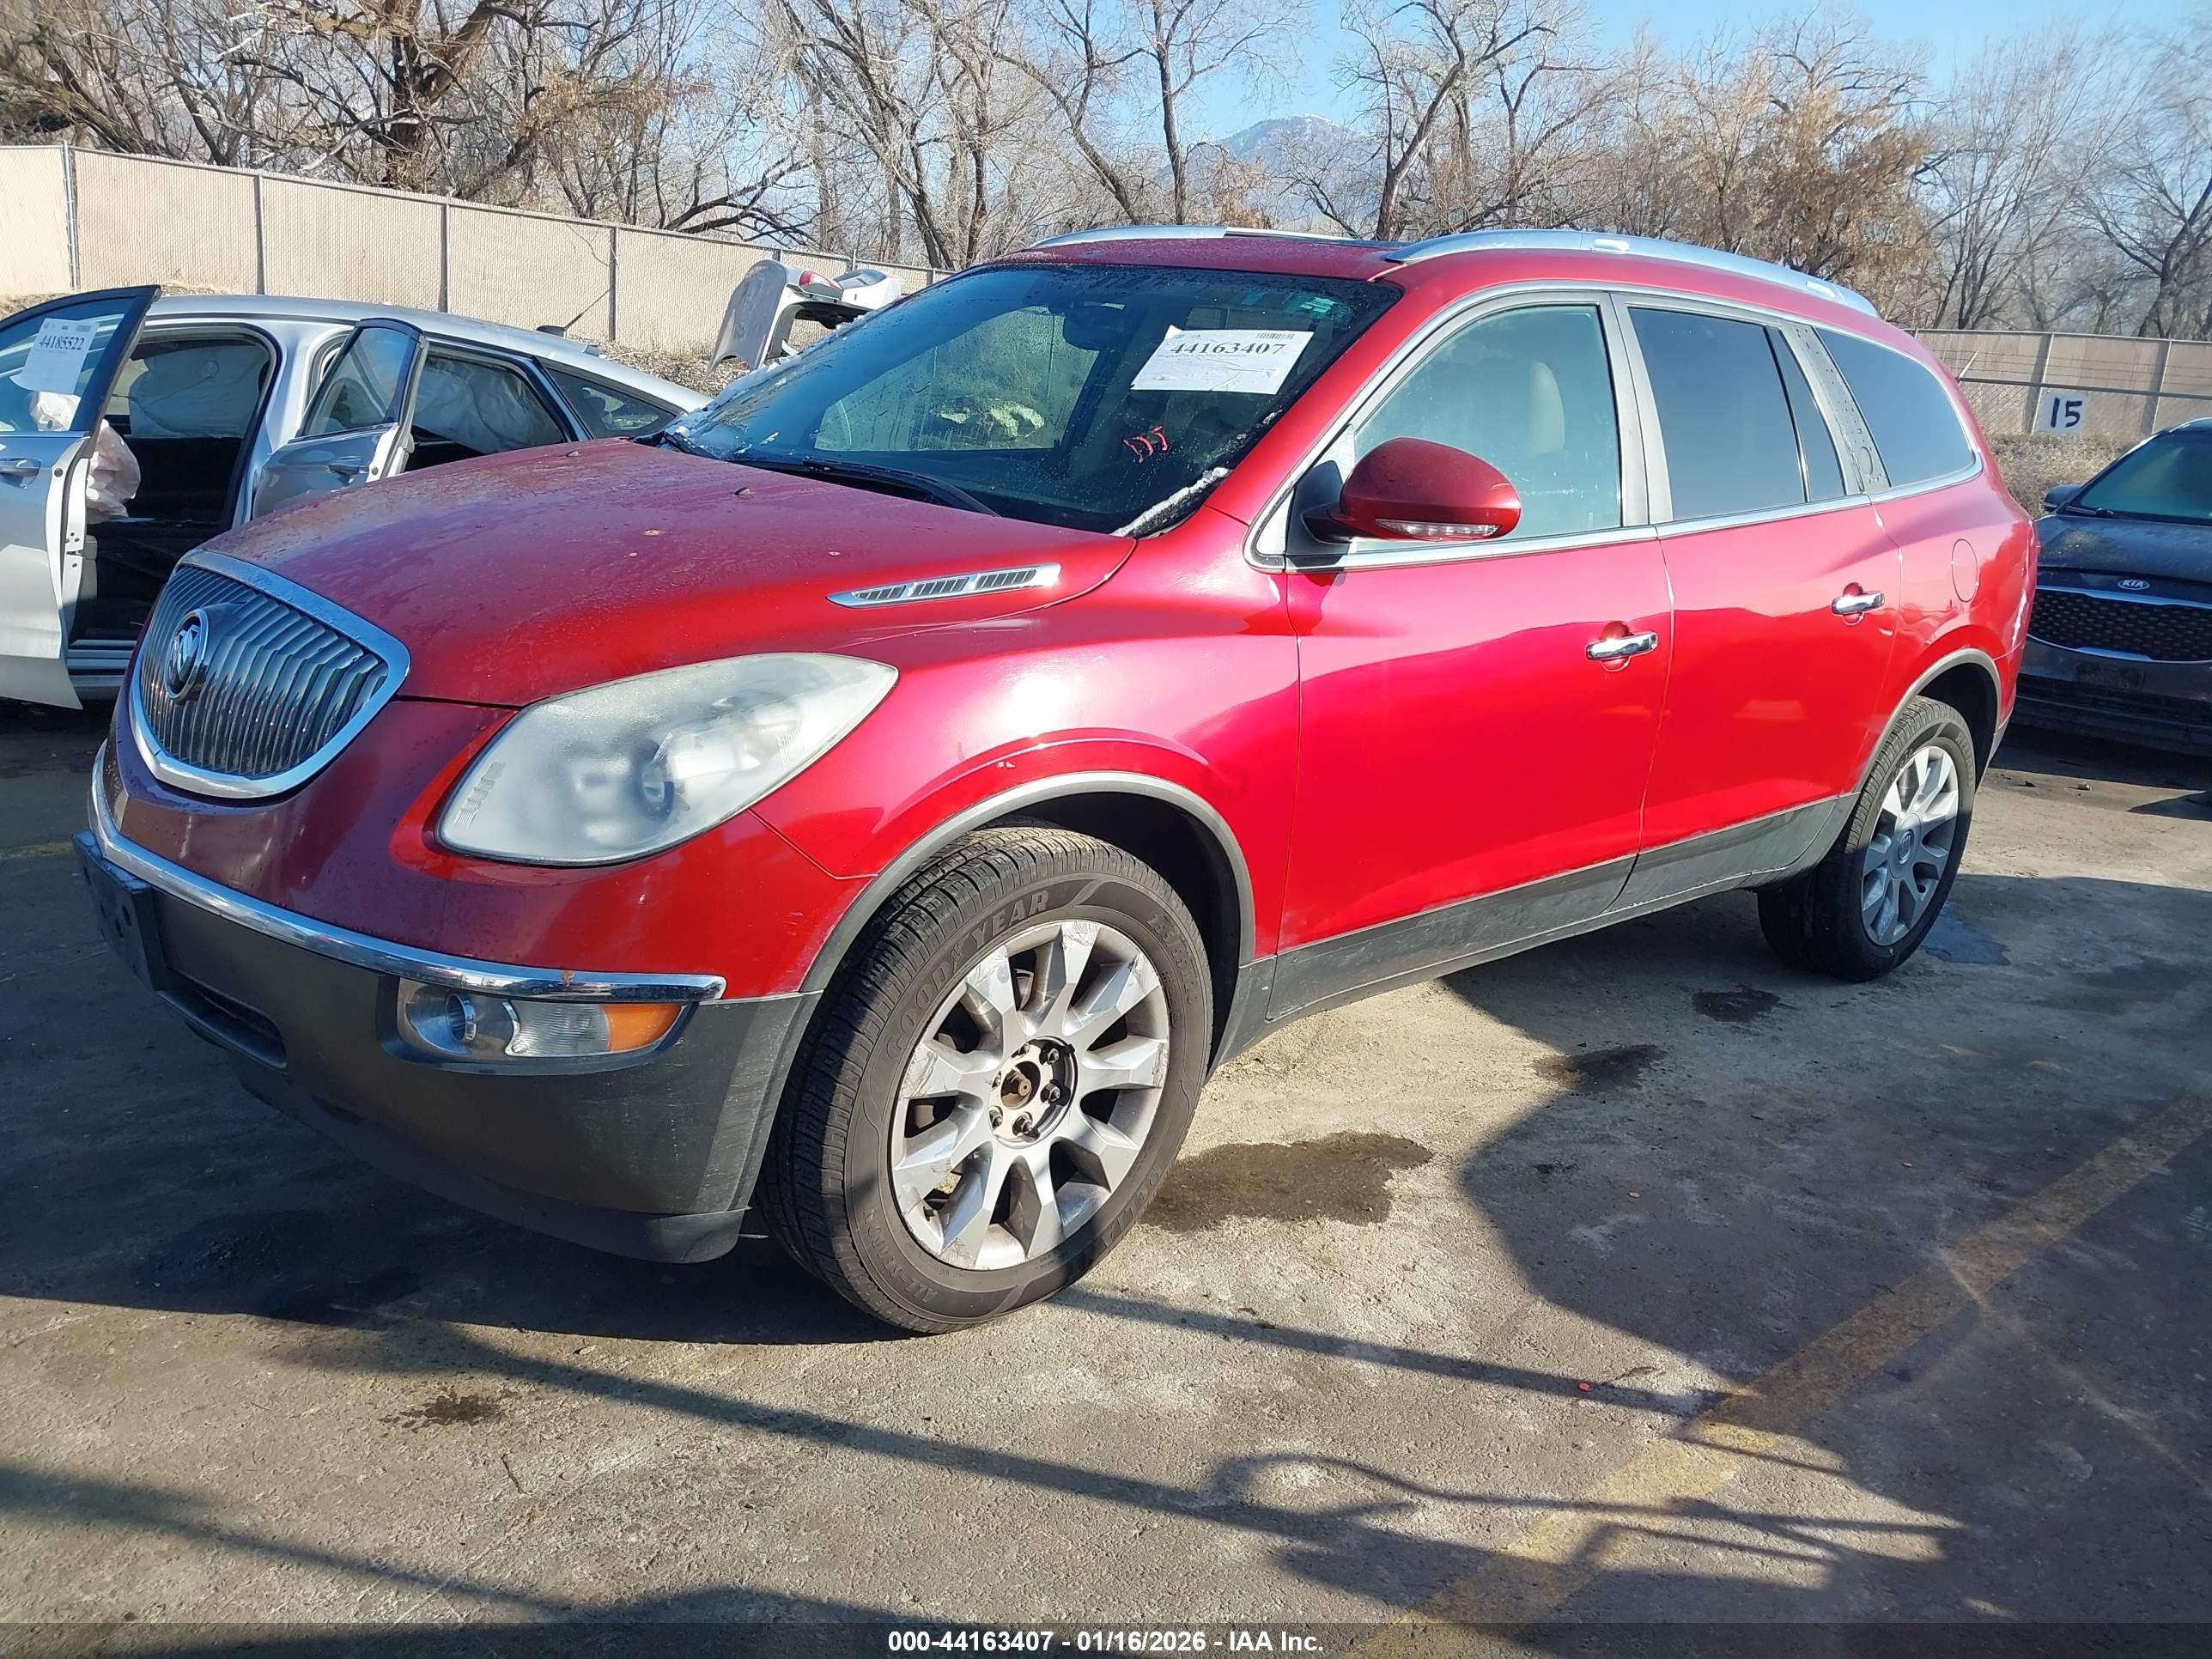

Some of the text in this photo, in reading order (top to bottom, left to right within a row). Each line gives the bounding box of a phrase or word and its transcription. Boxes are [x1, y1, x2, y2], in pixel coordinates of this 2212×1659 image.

[40, 334, 85, 351] 44185522
[1170, 343, 1286, 355] 44163407
[2051, 398, 2083, 428] 15
